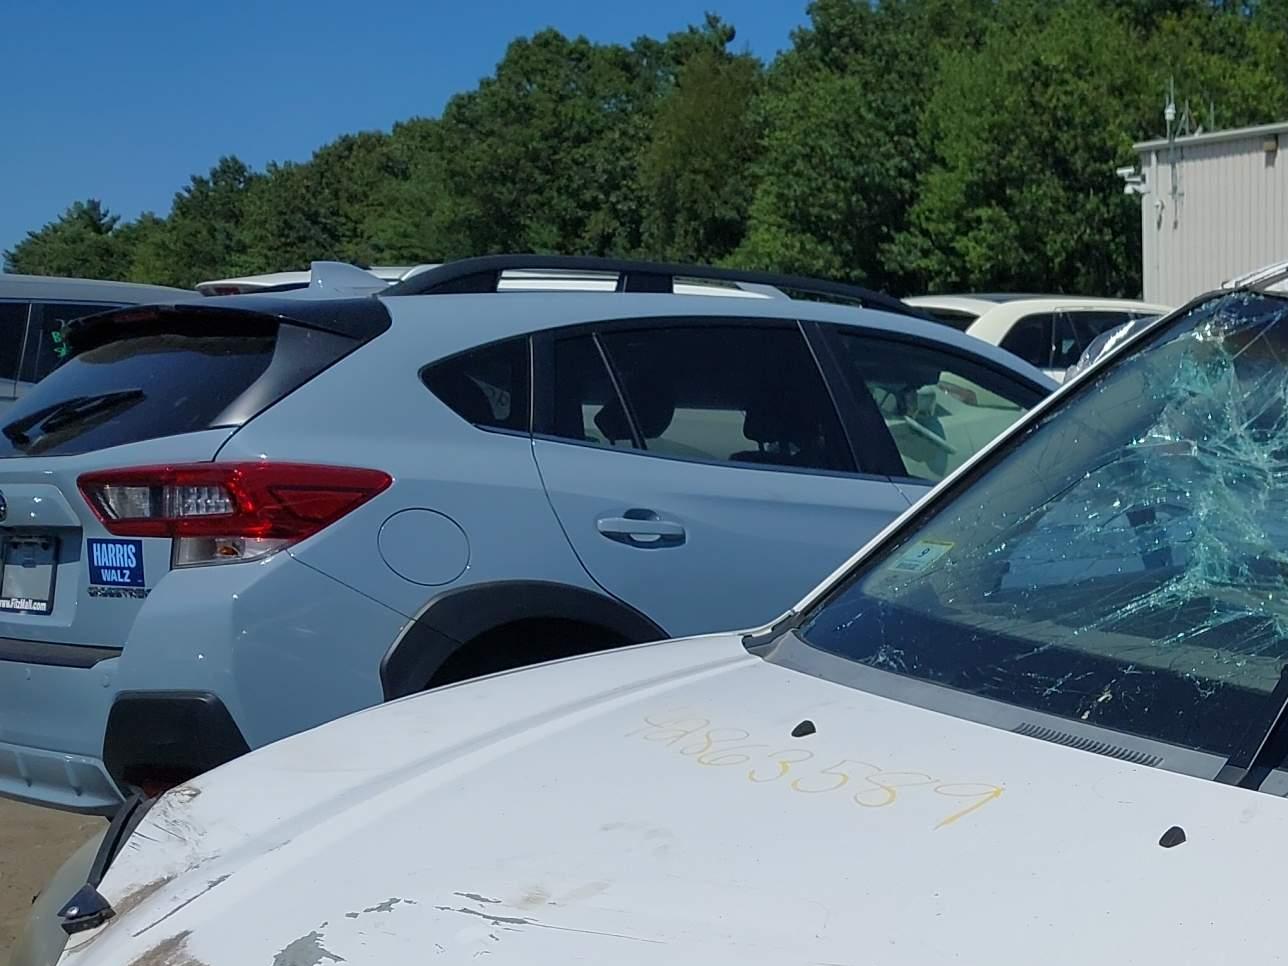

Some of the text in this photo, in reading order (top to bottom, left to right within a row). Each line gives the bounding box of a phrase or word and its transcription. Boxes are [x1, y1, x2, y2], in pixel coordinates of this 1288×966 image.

[93, 543, 136, 568] HARRIS
[101, 569, 131, 583] WALZ
[624, 713, 1006, 831] 42863589
